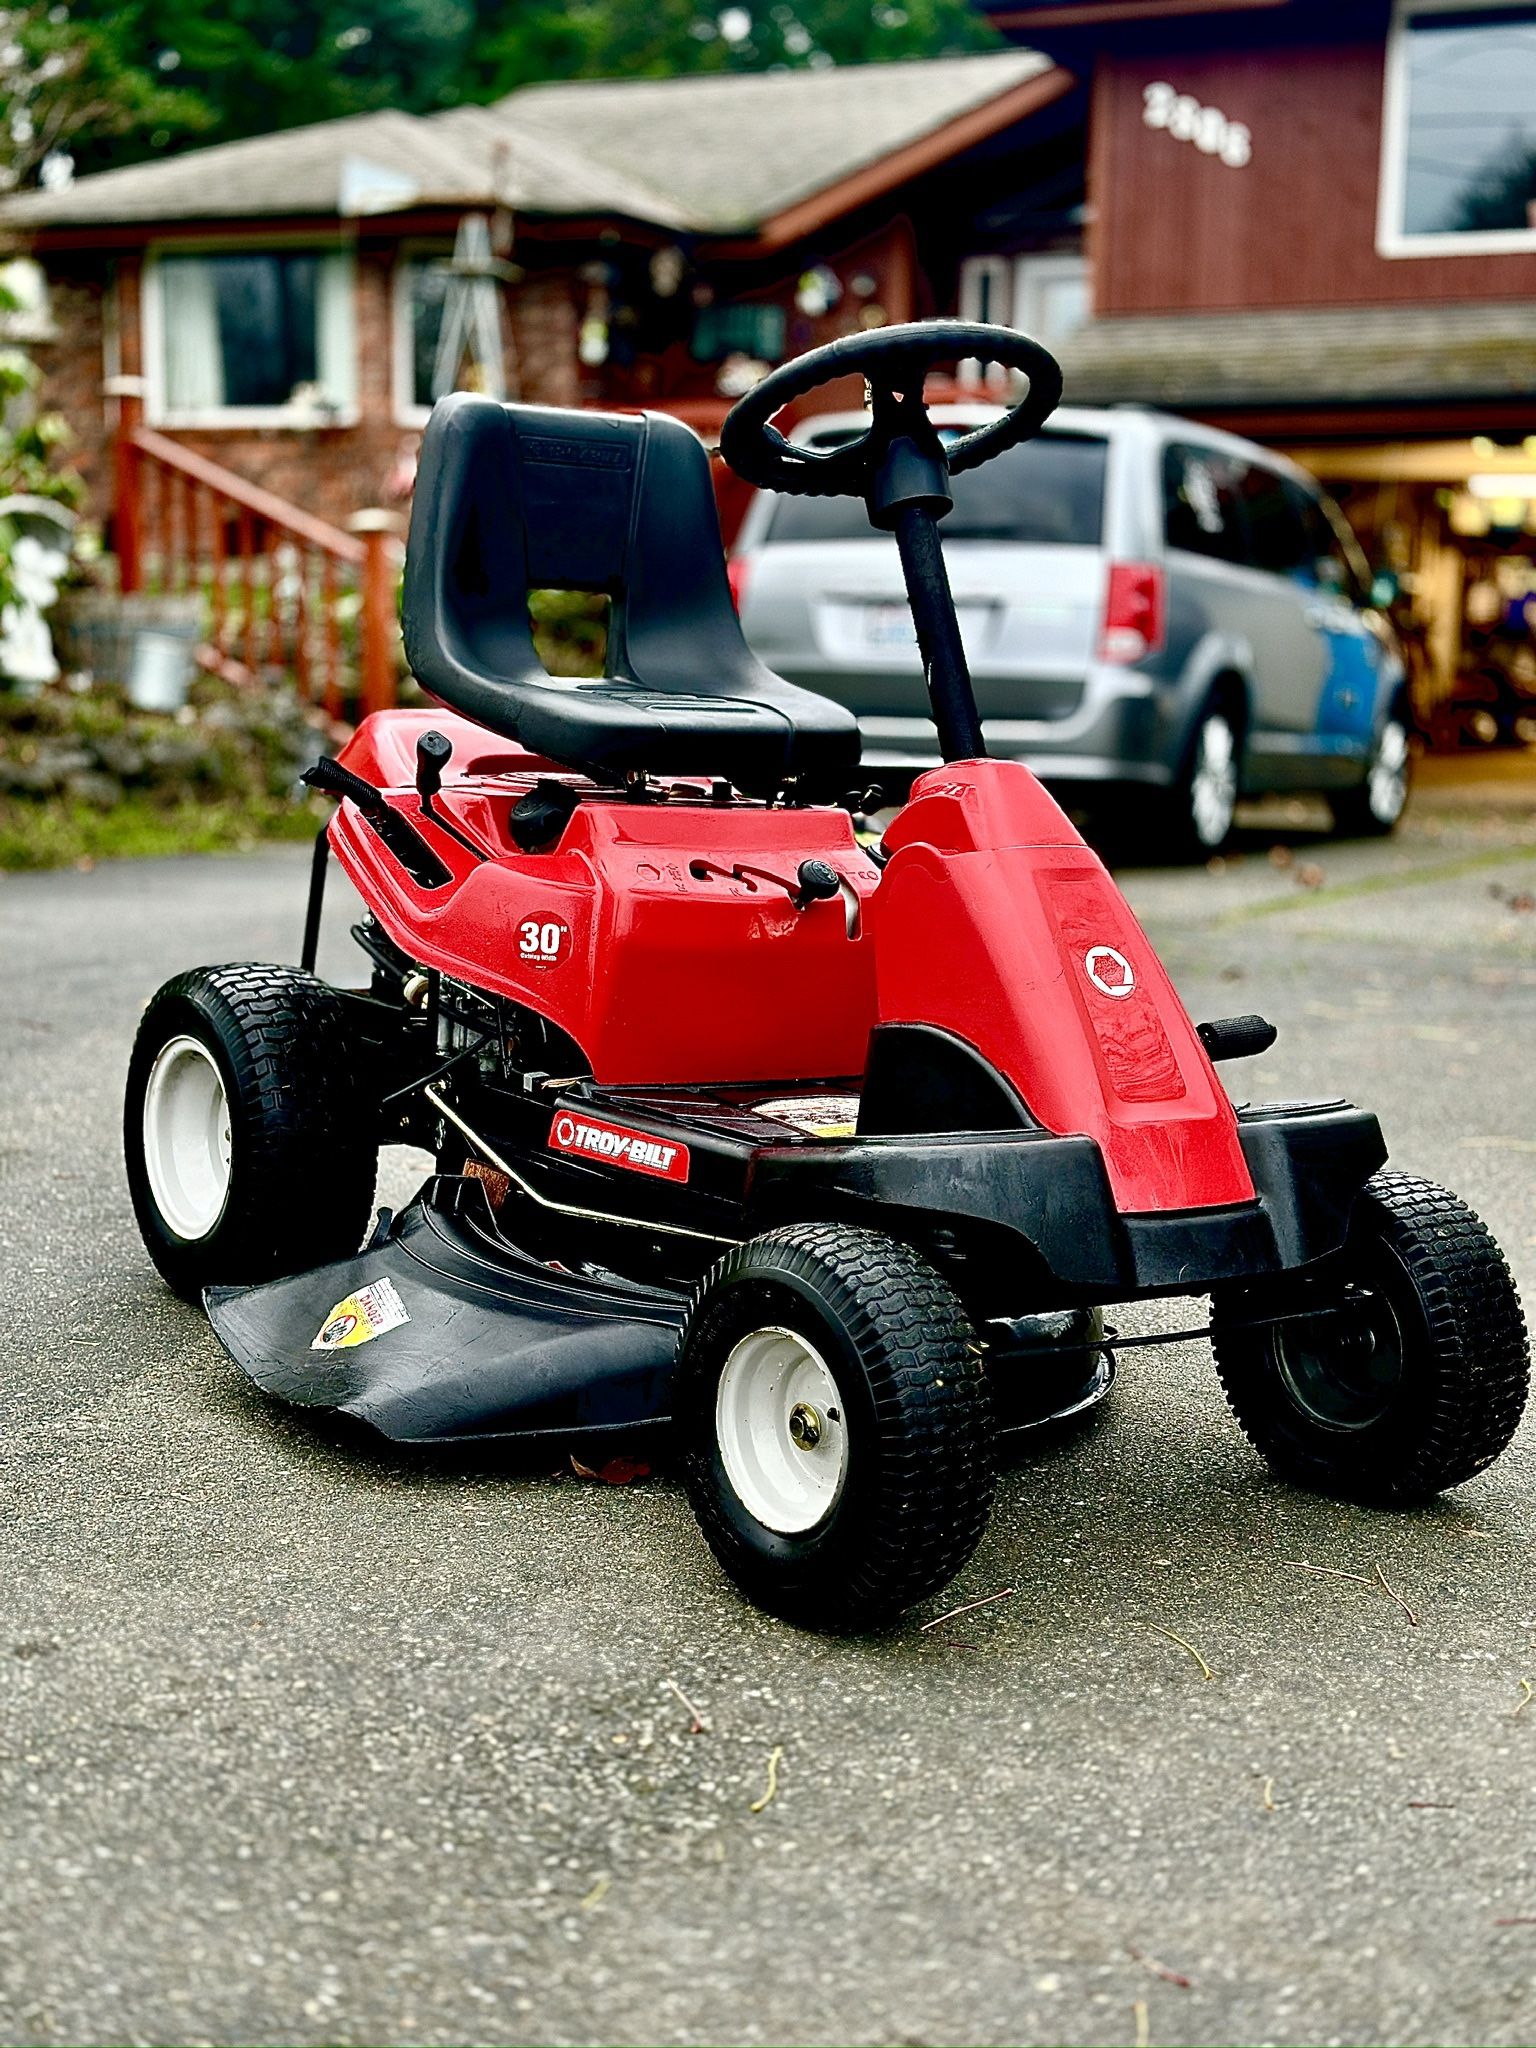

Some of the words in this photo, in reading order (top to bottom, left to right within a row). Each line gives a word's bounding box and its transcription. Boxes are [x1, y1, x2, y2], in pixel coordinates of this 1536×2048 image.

[519, 921, 568, 954] 30"
[575, 1124, 678, 1171] TROY-BILT
[360, 1294, 384, 1327] DANGER
